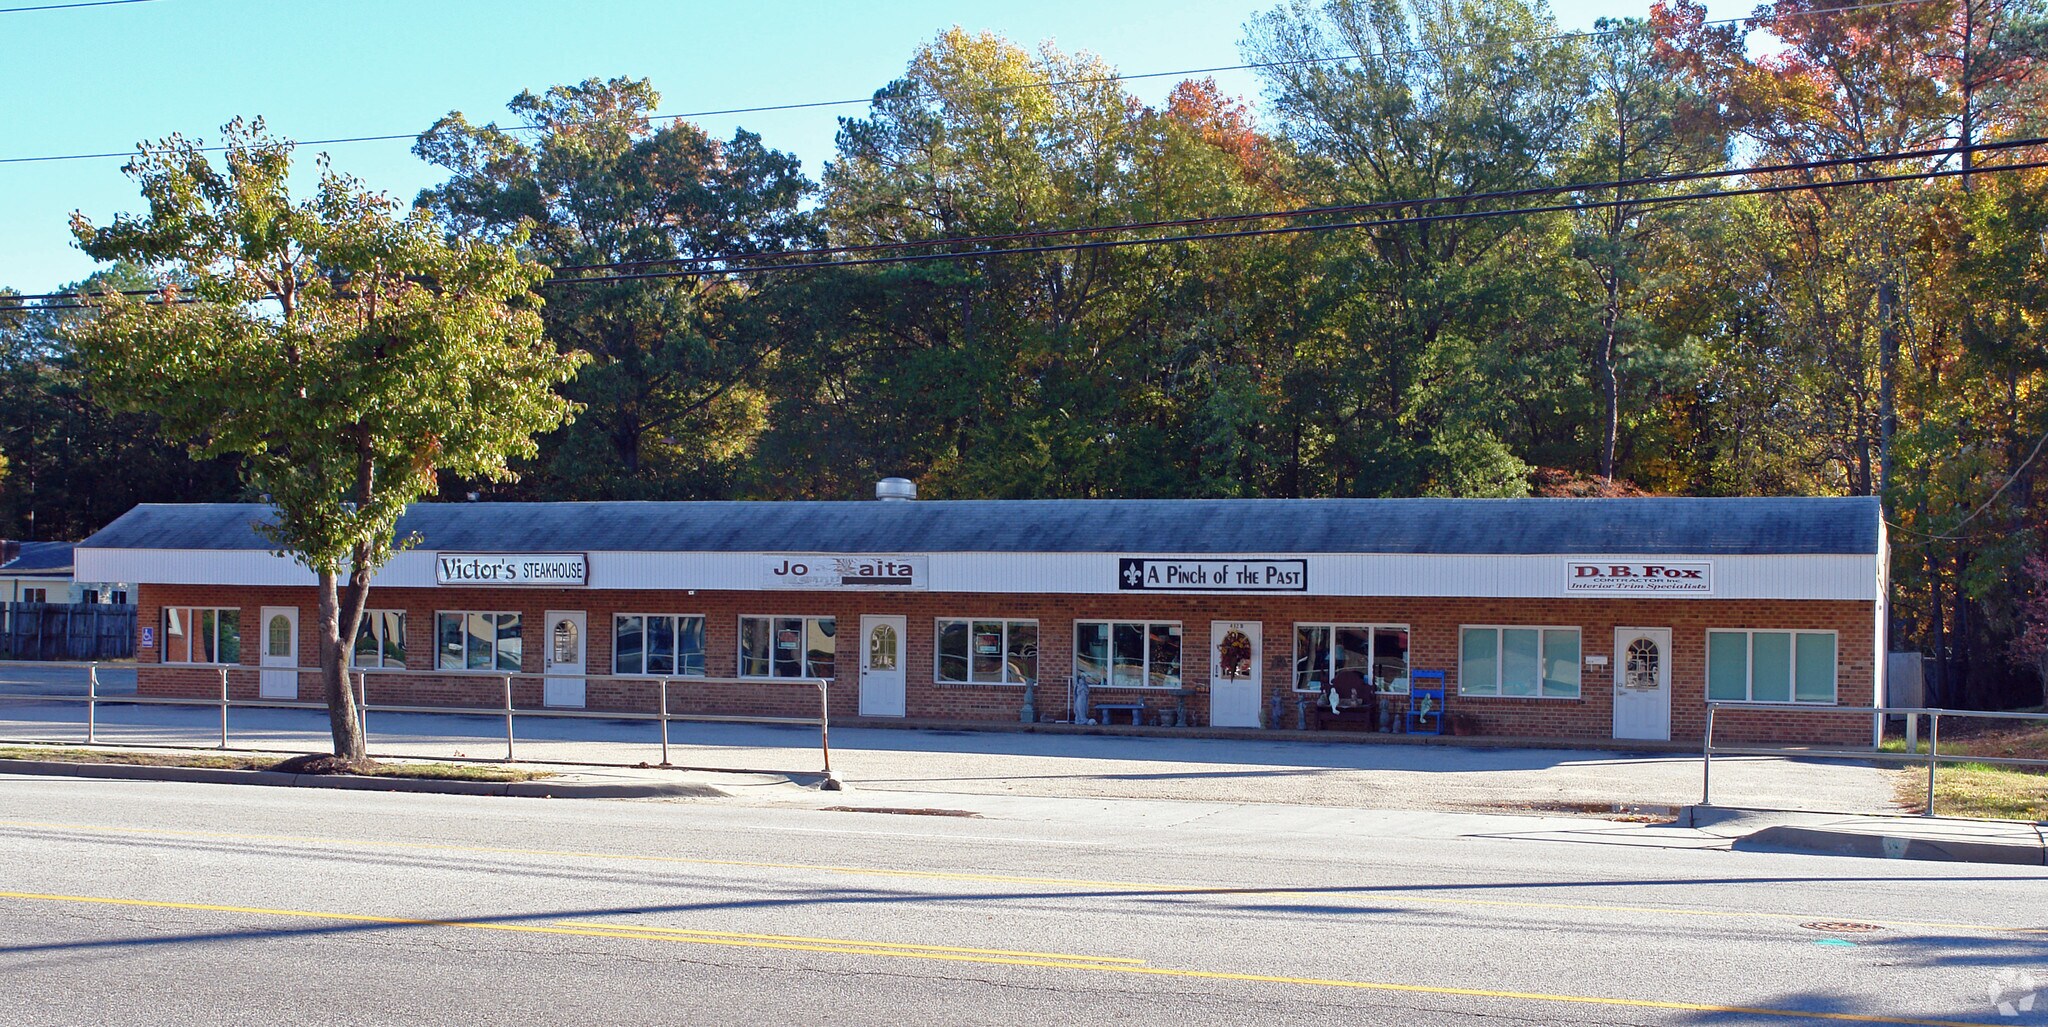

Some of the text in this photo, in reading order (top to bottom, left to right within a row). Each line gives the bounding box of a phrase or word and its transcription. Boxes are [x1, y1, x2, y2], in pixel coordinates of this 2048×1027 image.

[441, 558, 582, 579] Victor's STEAKHOUSE
[1147, 565, 1159, 584] A
